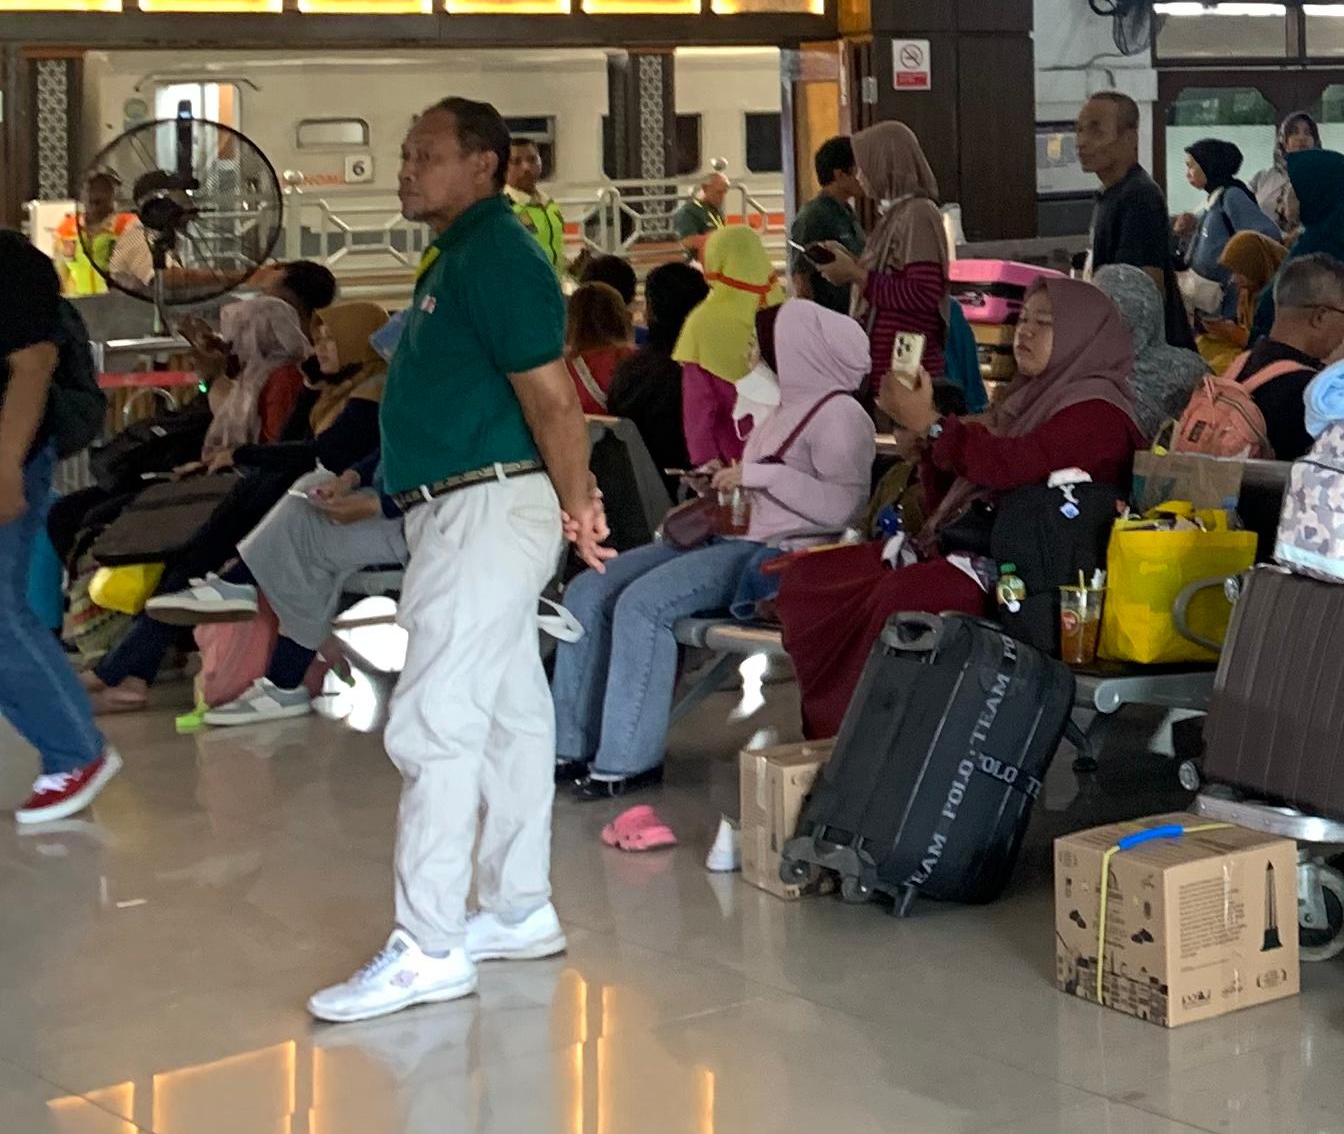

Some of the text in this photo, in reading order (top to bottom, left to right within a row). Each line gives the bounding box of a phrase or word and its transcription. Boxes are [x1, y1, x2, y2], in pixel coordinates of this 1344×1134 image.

[351, 160, 366, 177] 6
[942, 758, 976, 819] POLO
[969, 672, 1011, 743] TEAM
[1001, 633, 1018, 662] PO
